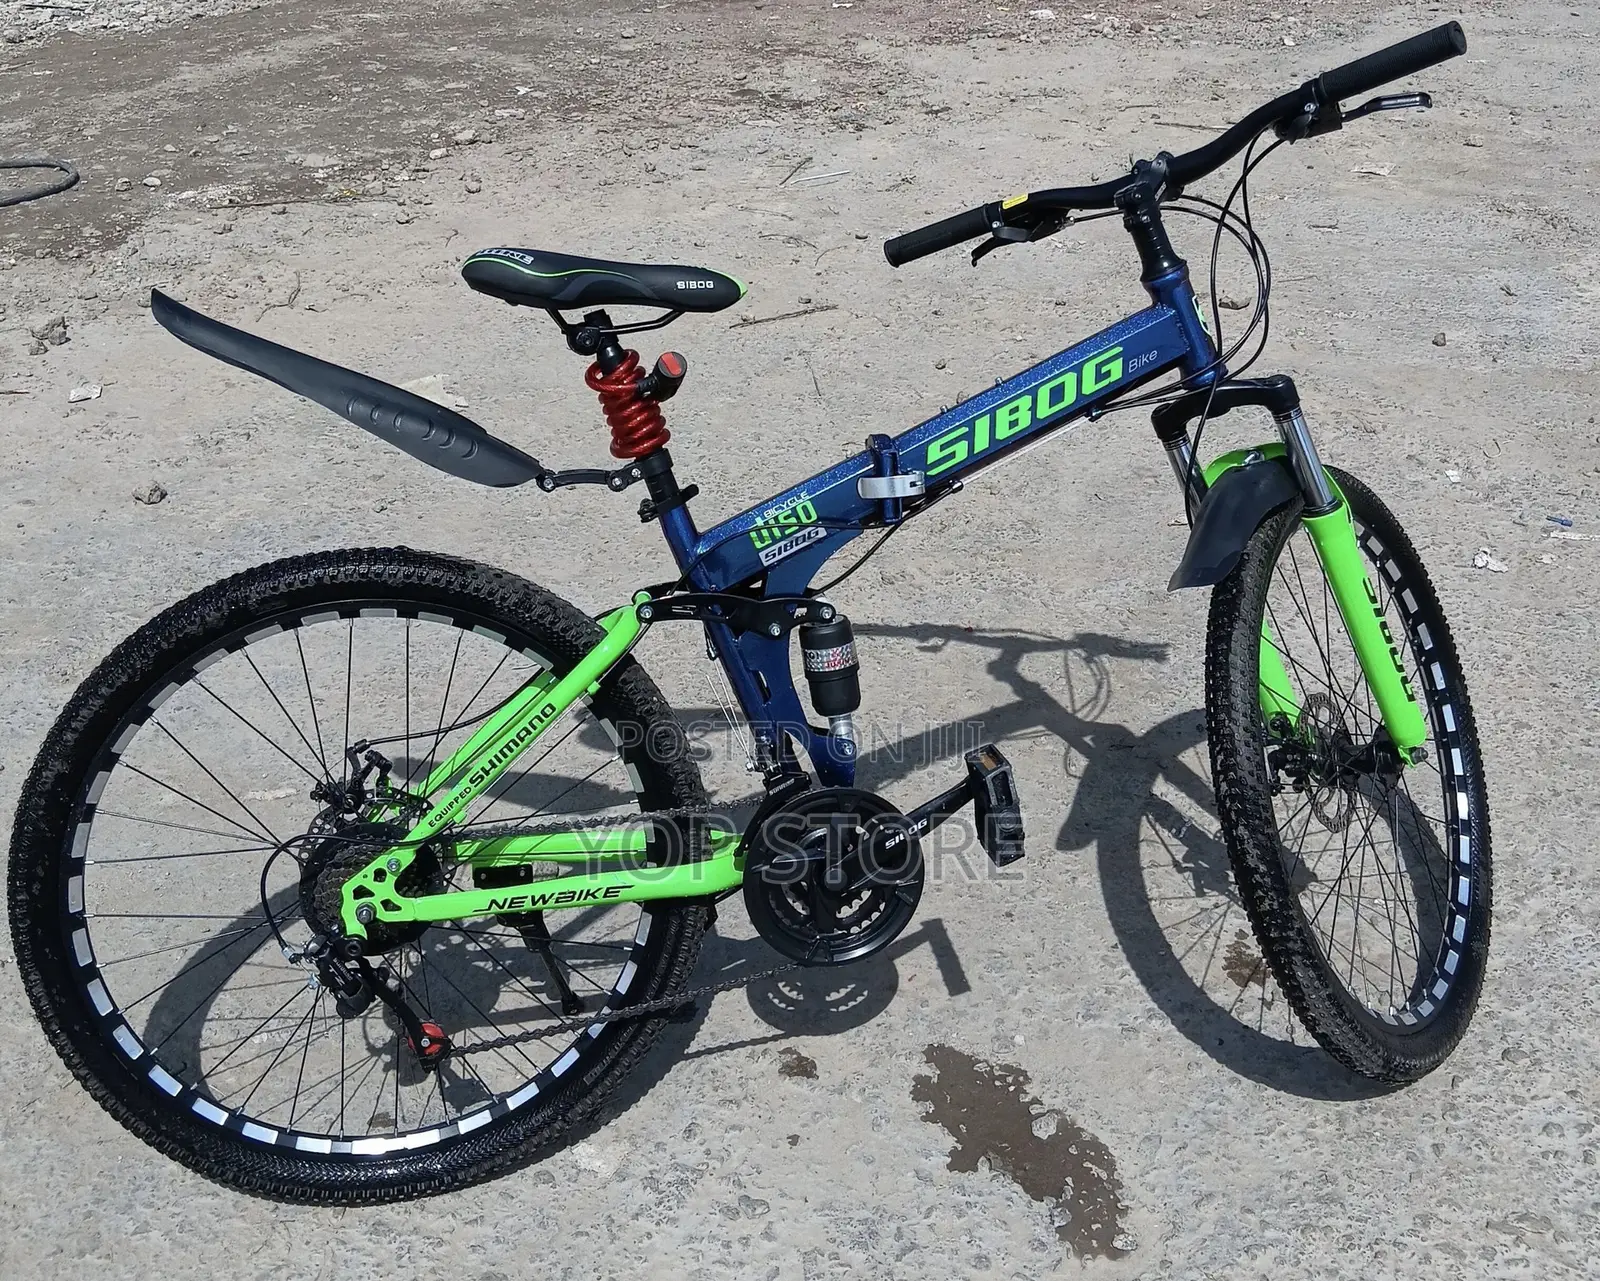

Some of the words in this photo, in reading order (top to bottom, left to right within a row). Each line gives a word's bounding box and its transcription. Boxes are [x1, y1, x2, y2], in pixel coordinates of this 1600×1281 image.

[676, 280, 714, 289] SIBOG
[926, 346, 1124, 476] SIBOG
[1128, 349, 1158, 374] Bike
[763, 489, 810, 518] BICYCLE
[764, 527, 820, 563] SIBOG
[427, 786, 472, 828] EQUIPPED
[468, 702, 557, 788] SHIMANO
[472, 884, 635, 913] NEWBIKE
